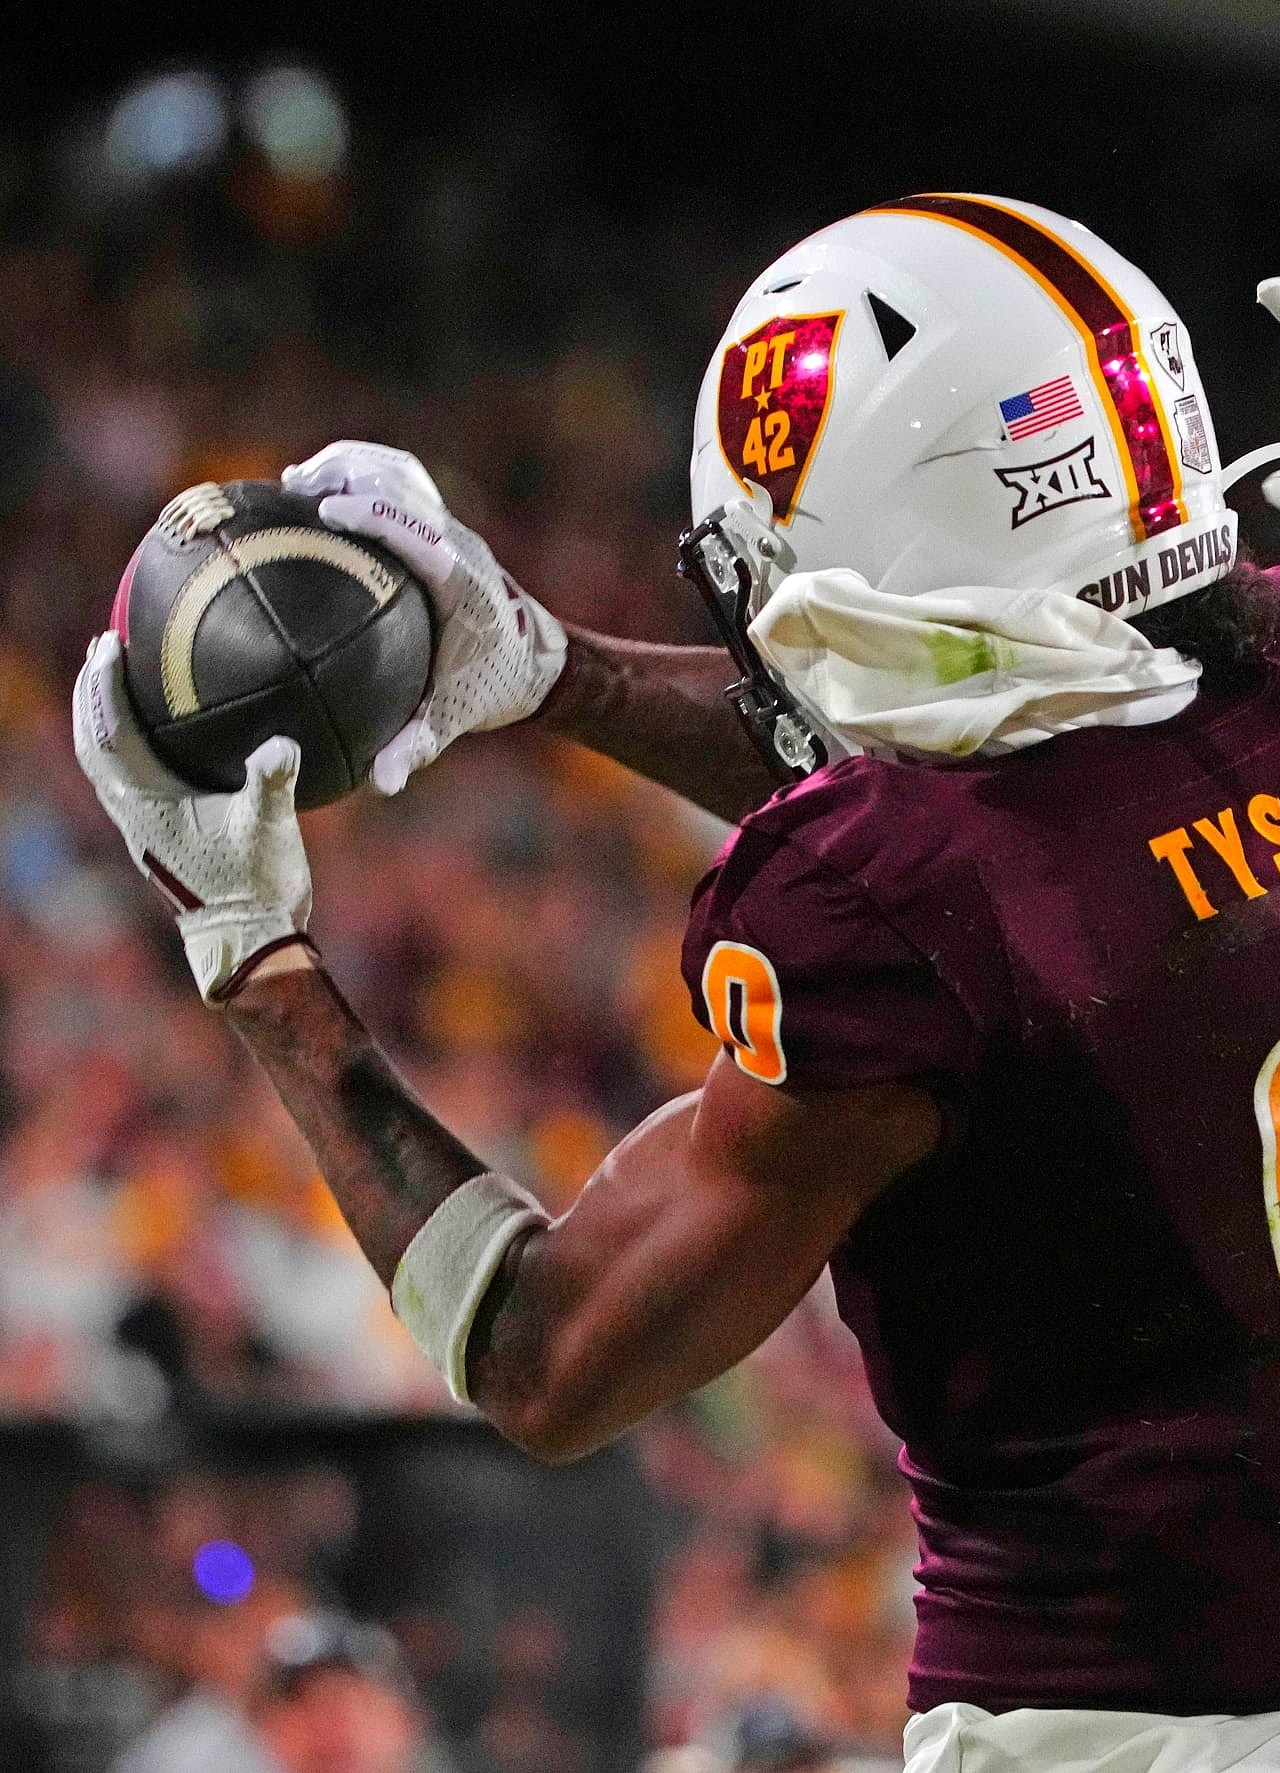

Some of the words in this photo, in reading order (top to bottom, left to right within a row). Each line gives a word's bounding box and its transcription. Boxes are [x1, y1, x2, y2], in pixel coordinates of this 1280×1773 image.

[741, 331, 796, 400] PT
[742, 410, 796, 475] 42
[1076, 559, 1151, 613] SUN
[1158, 524, 1232, 589] DEVILS
[702, 940, 788, 1086] 0
